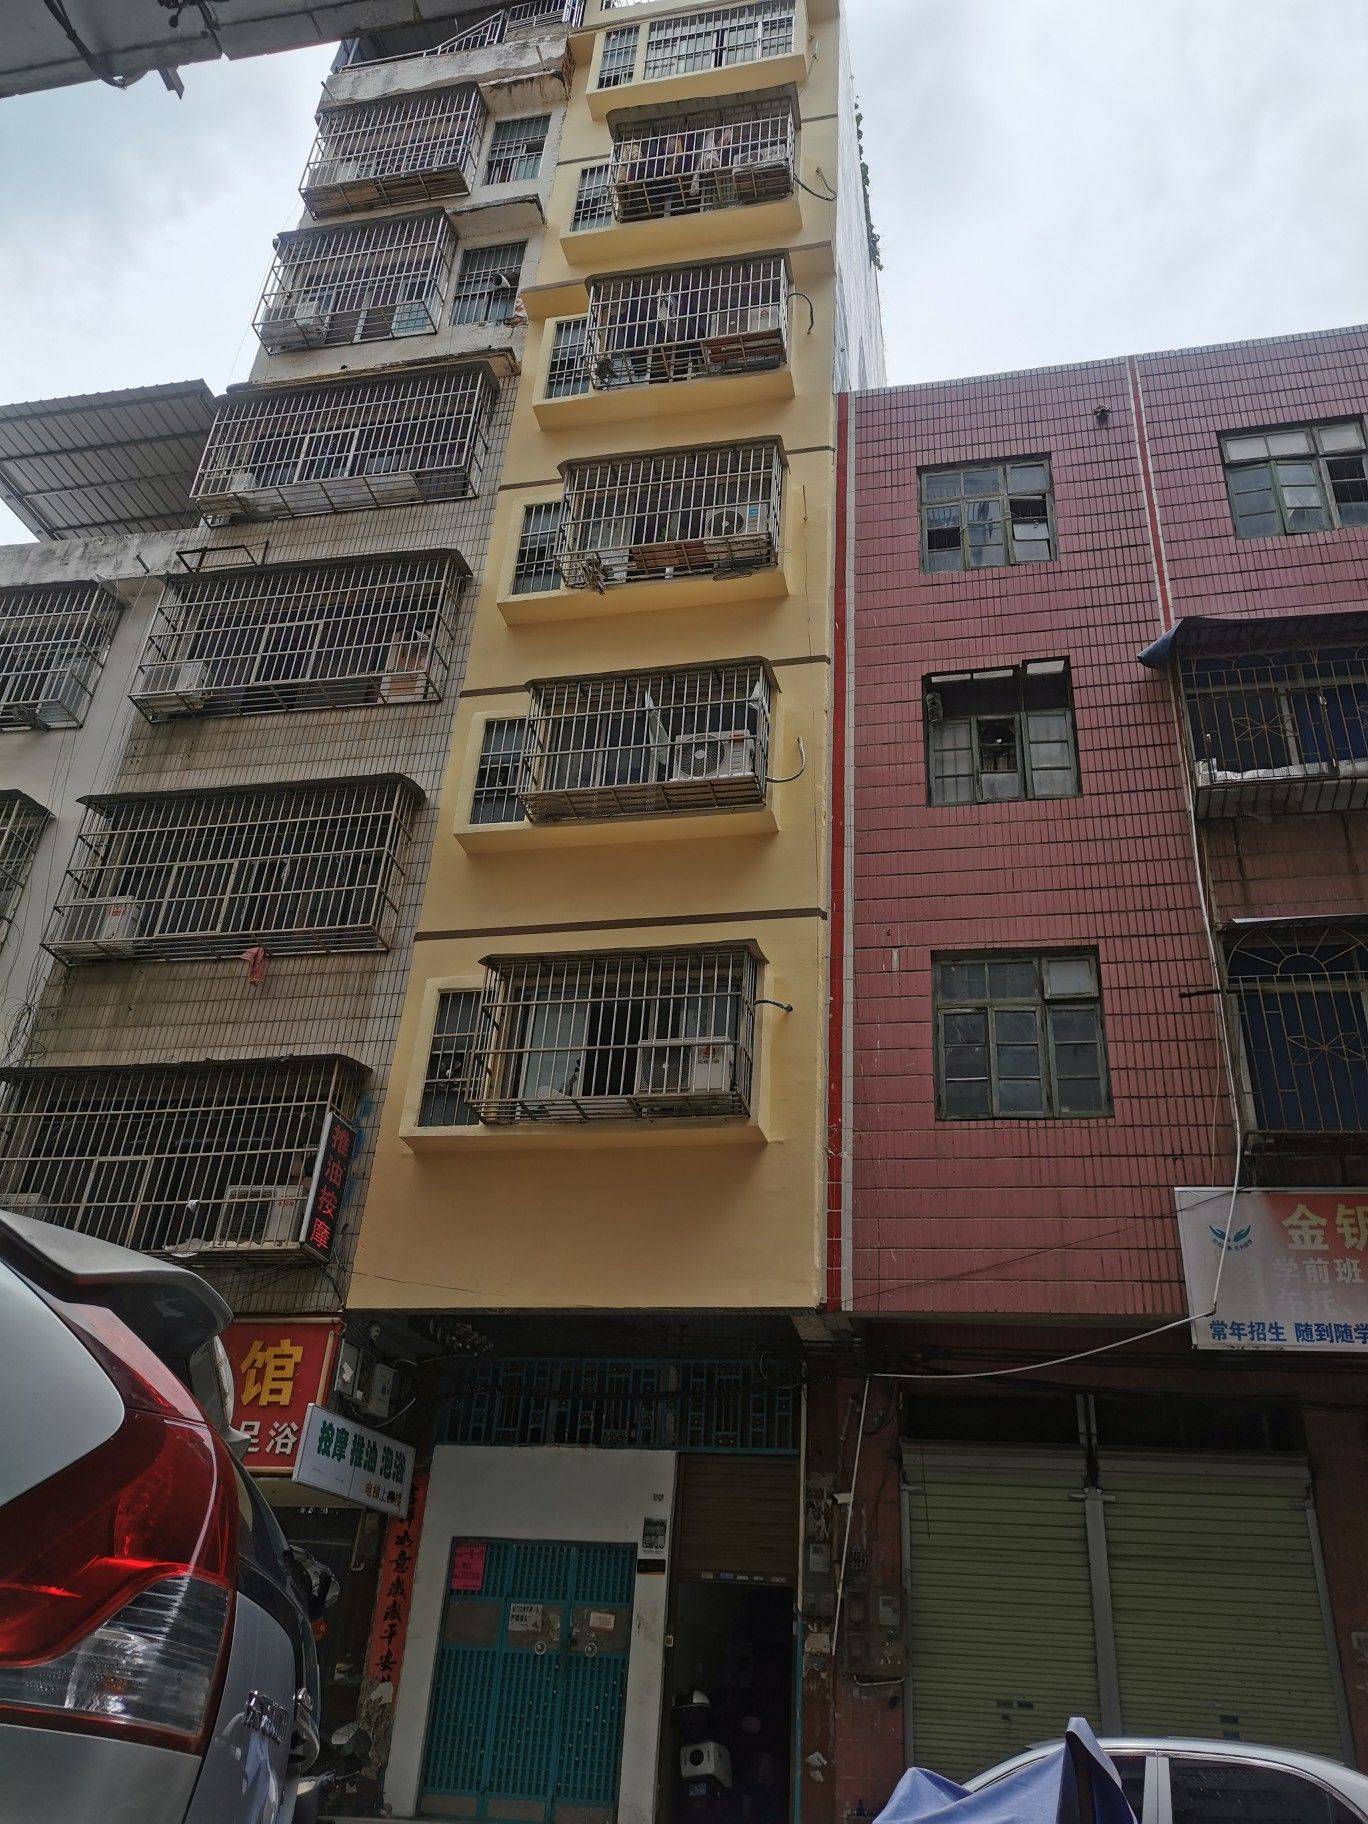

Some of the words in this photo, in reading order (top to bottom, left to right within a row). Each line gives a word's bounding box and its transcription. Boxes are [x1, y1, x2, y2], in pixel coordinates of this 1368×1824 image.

[1271, 1257, 1364, 1284] 学前班
[1210, 1320, 1287, 1343] 常年招生
[1294, 1321, 1368, 1345] 随到随学
[240, 1338, 304, 1407] 馆
[317, 1420, 350, 1463] 按摩
